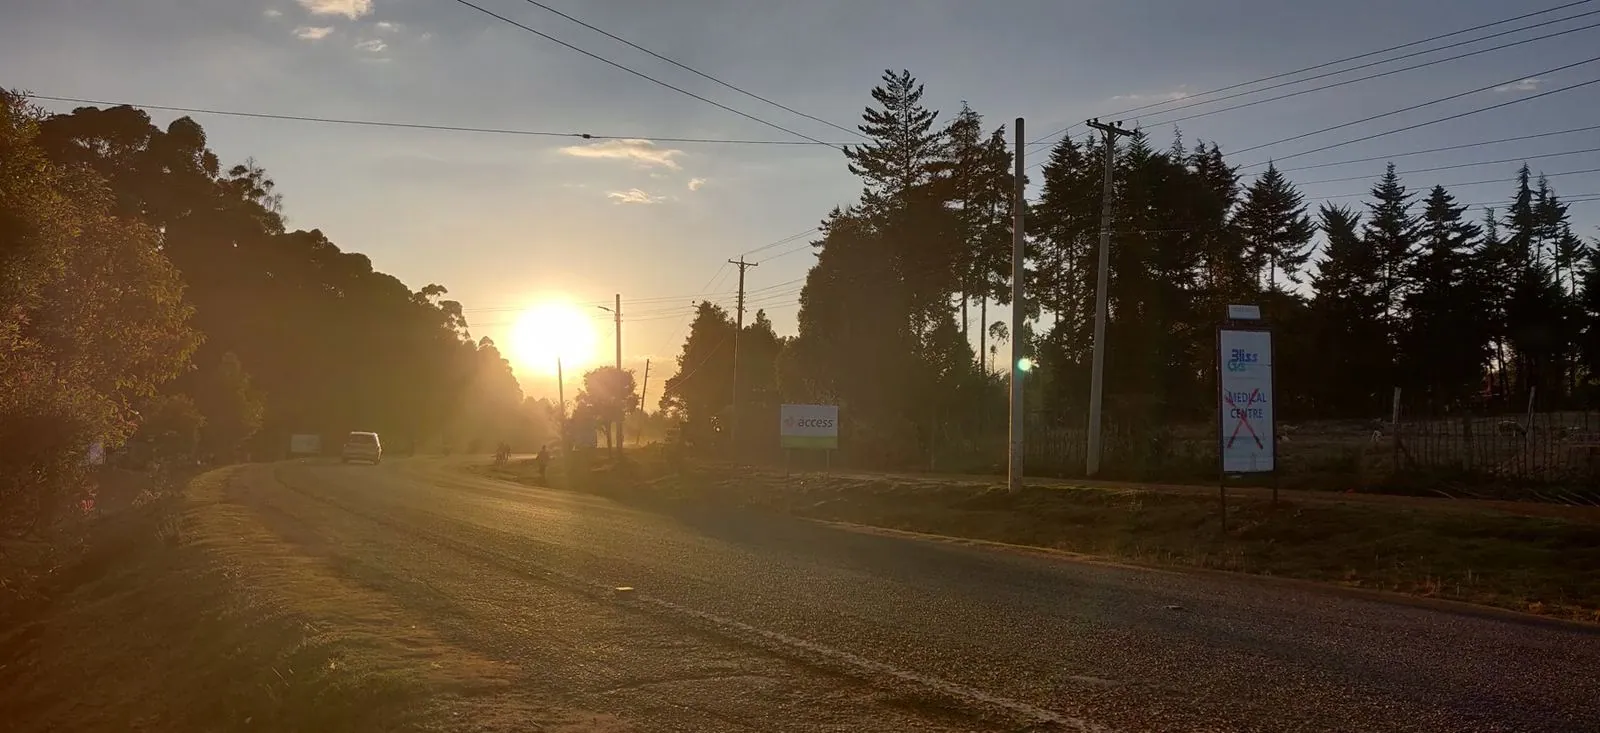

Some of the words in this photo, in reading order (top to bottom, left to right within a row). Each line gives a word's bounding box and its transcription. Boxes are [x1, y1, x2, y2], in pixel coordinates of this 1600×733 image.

[1231, 348, 1259, 362] Bliss
[1228, 391, 1267, 402] MEDICAL
[1230, 408, 1264, 419] CENTRE
[798, 418, 834, 428] access
